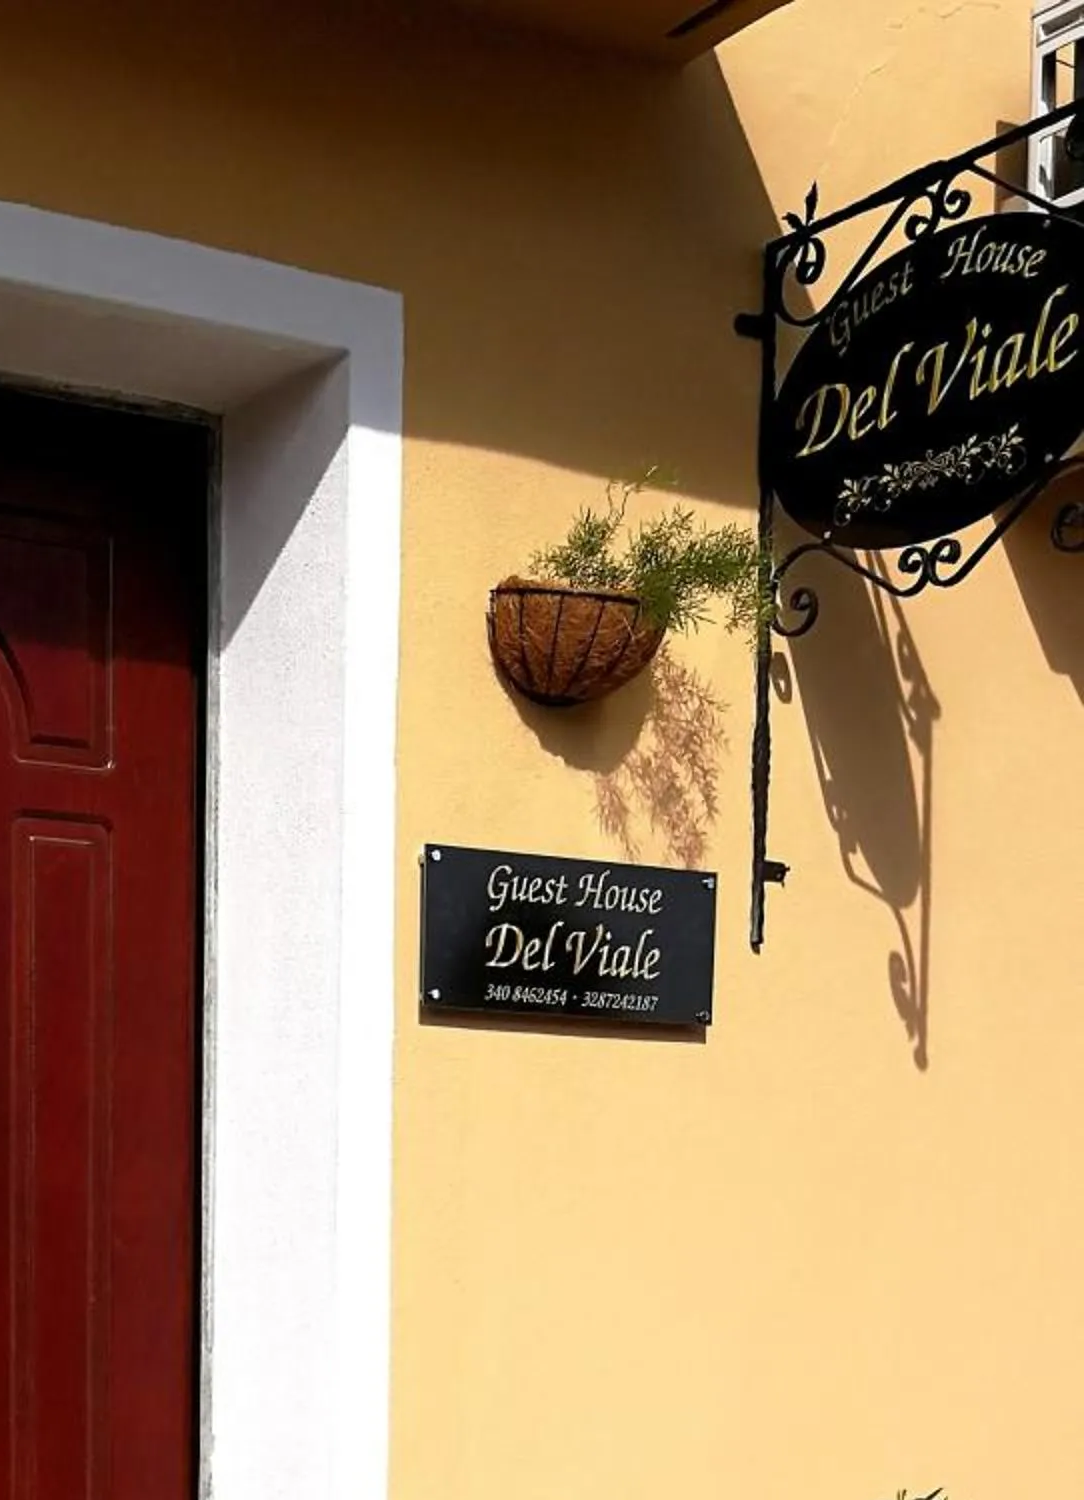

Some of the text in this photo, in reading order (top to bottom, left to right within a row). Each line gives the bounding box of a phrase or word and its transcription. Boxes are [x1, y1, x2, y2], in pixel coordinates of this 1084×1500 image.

[826, 225, 1047, 356] Guest House
[796, 284, 1079, 458] Del Viale
[487, 865, 663, 914] Guest House
[485, 921, 661, 979] Del Viale
[484, 983, 511, 1001] 340
